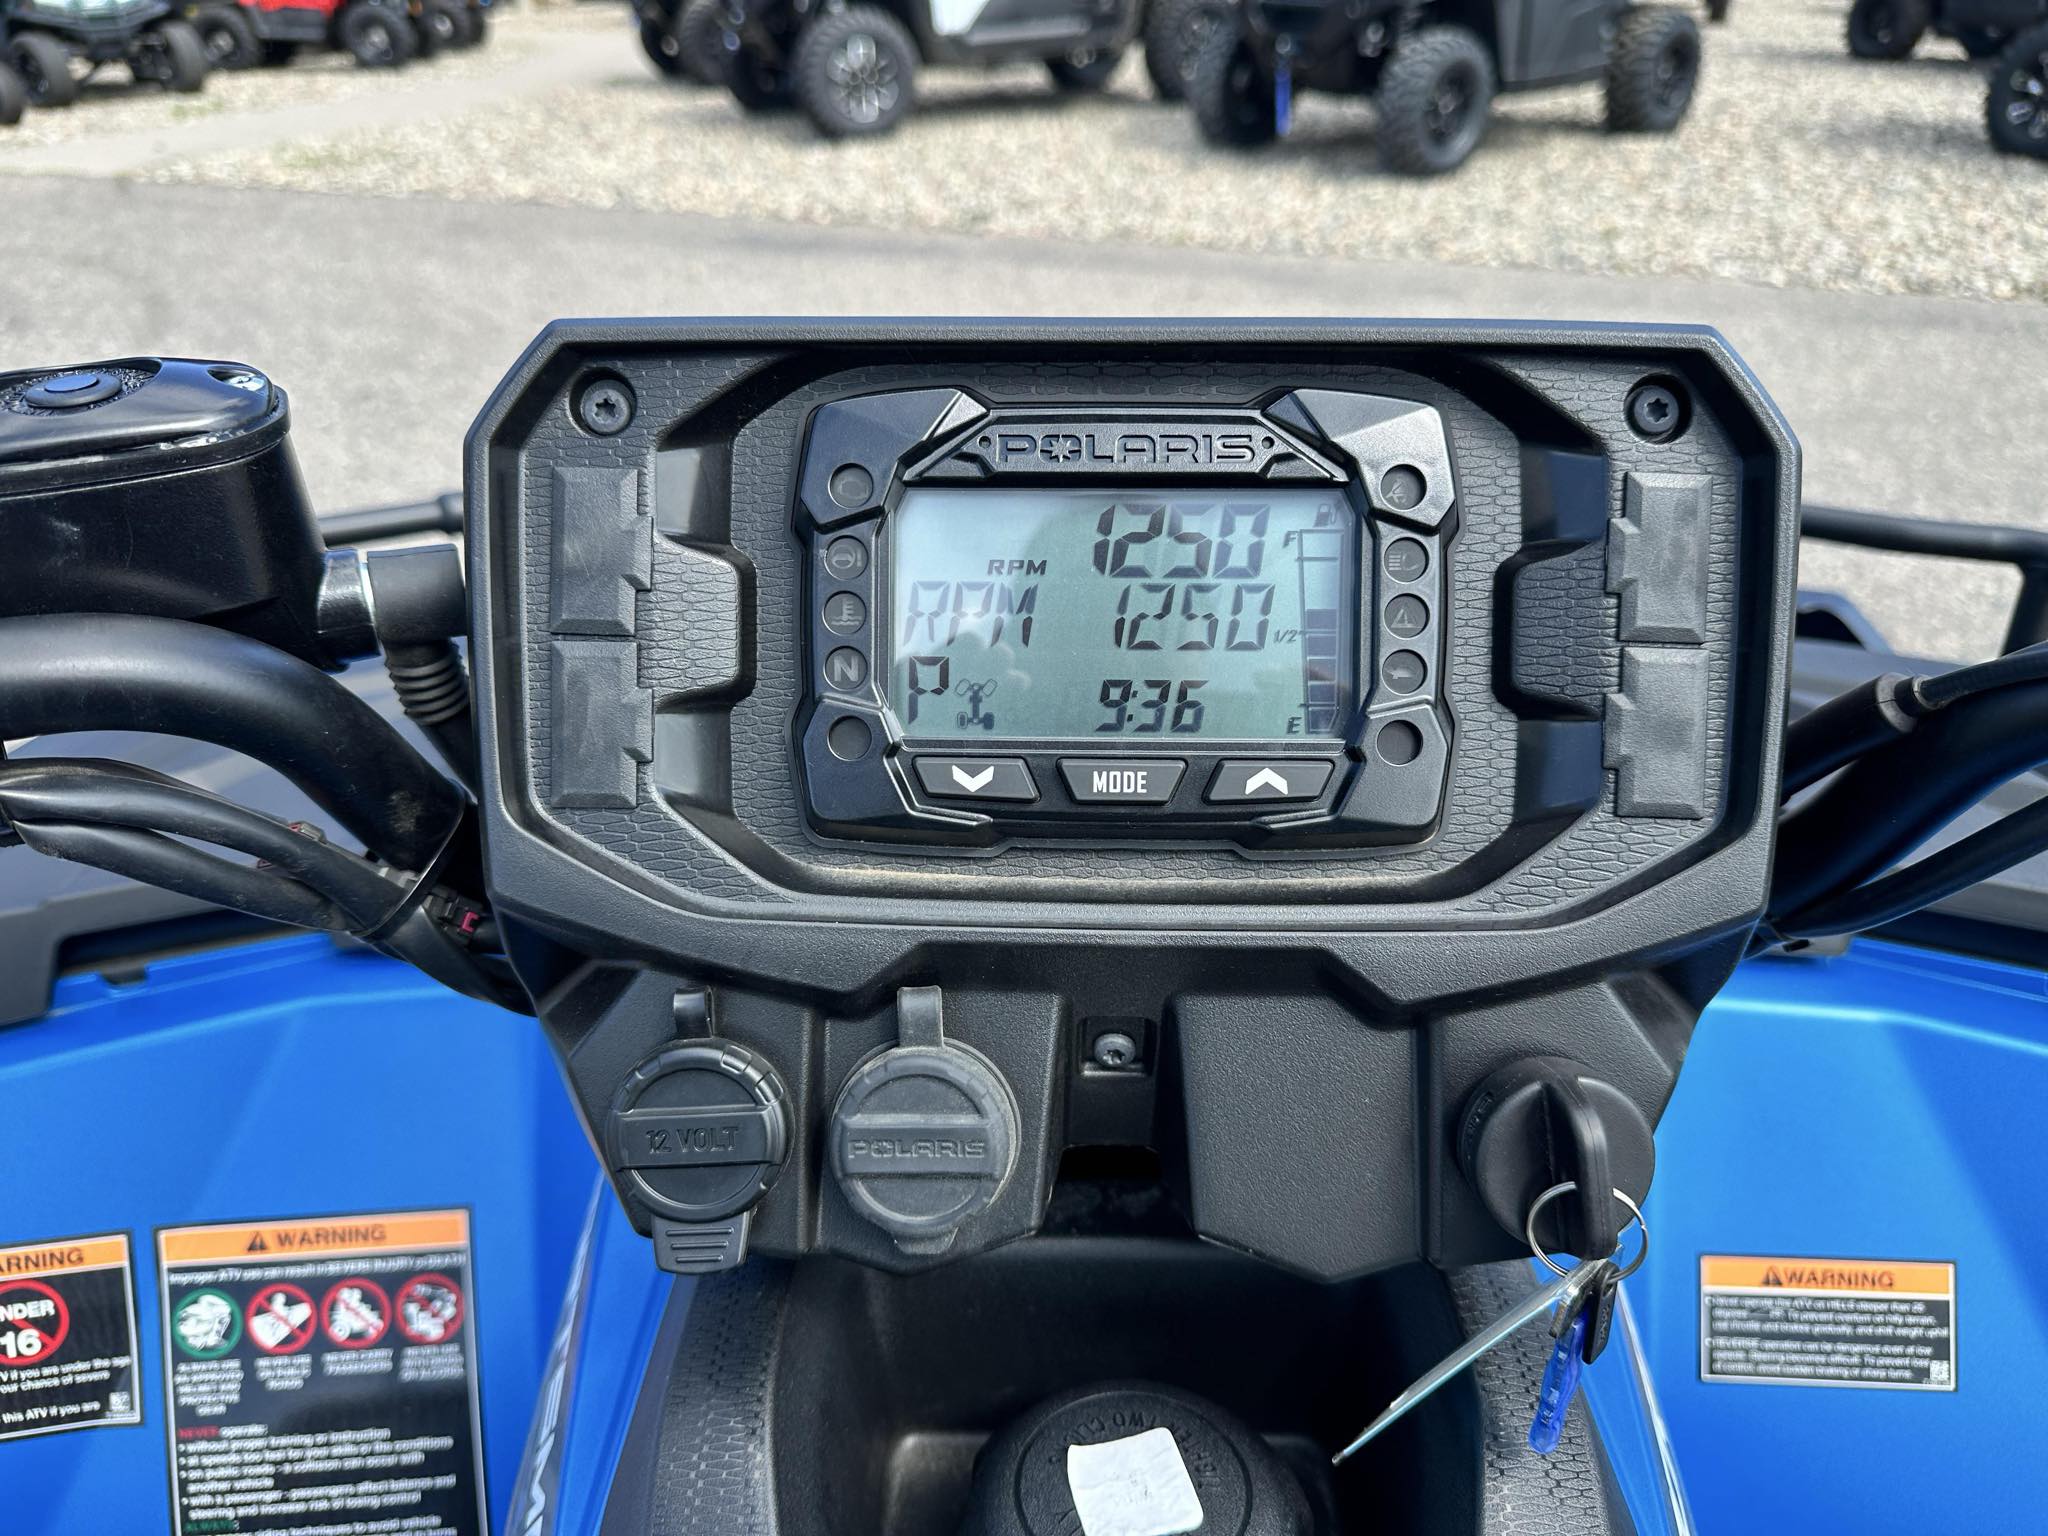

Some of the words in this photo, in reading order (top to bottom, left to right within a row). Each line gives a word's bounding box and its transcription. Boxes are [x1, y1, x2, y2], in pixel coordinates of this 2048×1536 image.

[997, 433, 1255, 464] POLARIS
[1093, 503, 1270, 578] 1250
[987, 559, 1047, 576] RPM
[903, 581, 1038, 647] RPM
[1115, 583, 1275, 650] 1250
[908, 656, 949, 724] P
[1095, 680, 1209, 732] 9:36
[1093, 770, 1147, 794] MODE
[646, 1129, 667, 1154] 12
[677, 1126, 739, 1152] VOLT
[848, 1140, 985, 1159] POLARIS
[277, 1224, 387, 1248] WARNING
[1784, 1266, 1895, 1288] WARNING
[1, 1328, 42, 1358] 16
[20, 1368, 40, 1380] you
[20, 1377, 60, 1391] chance
[1, 1411, 24, 1424] this
[25, 1406, 48, 1420] ATV
[59, 1404, 80, 1417] you
